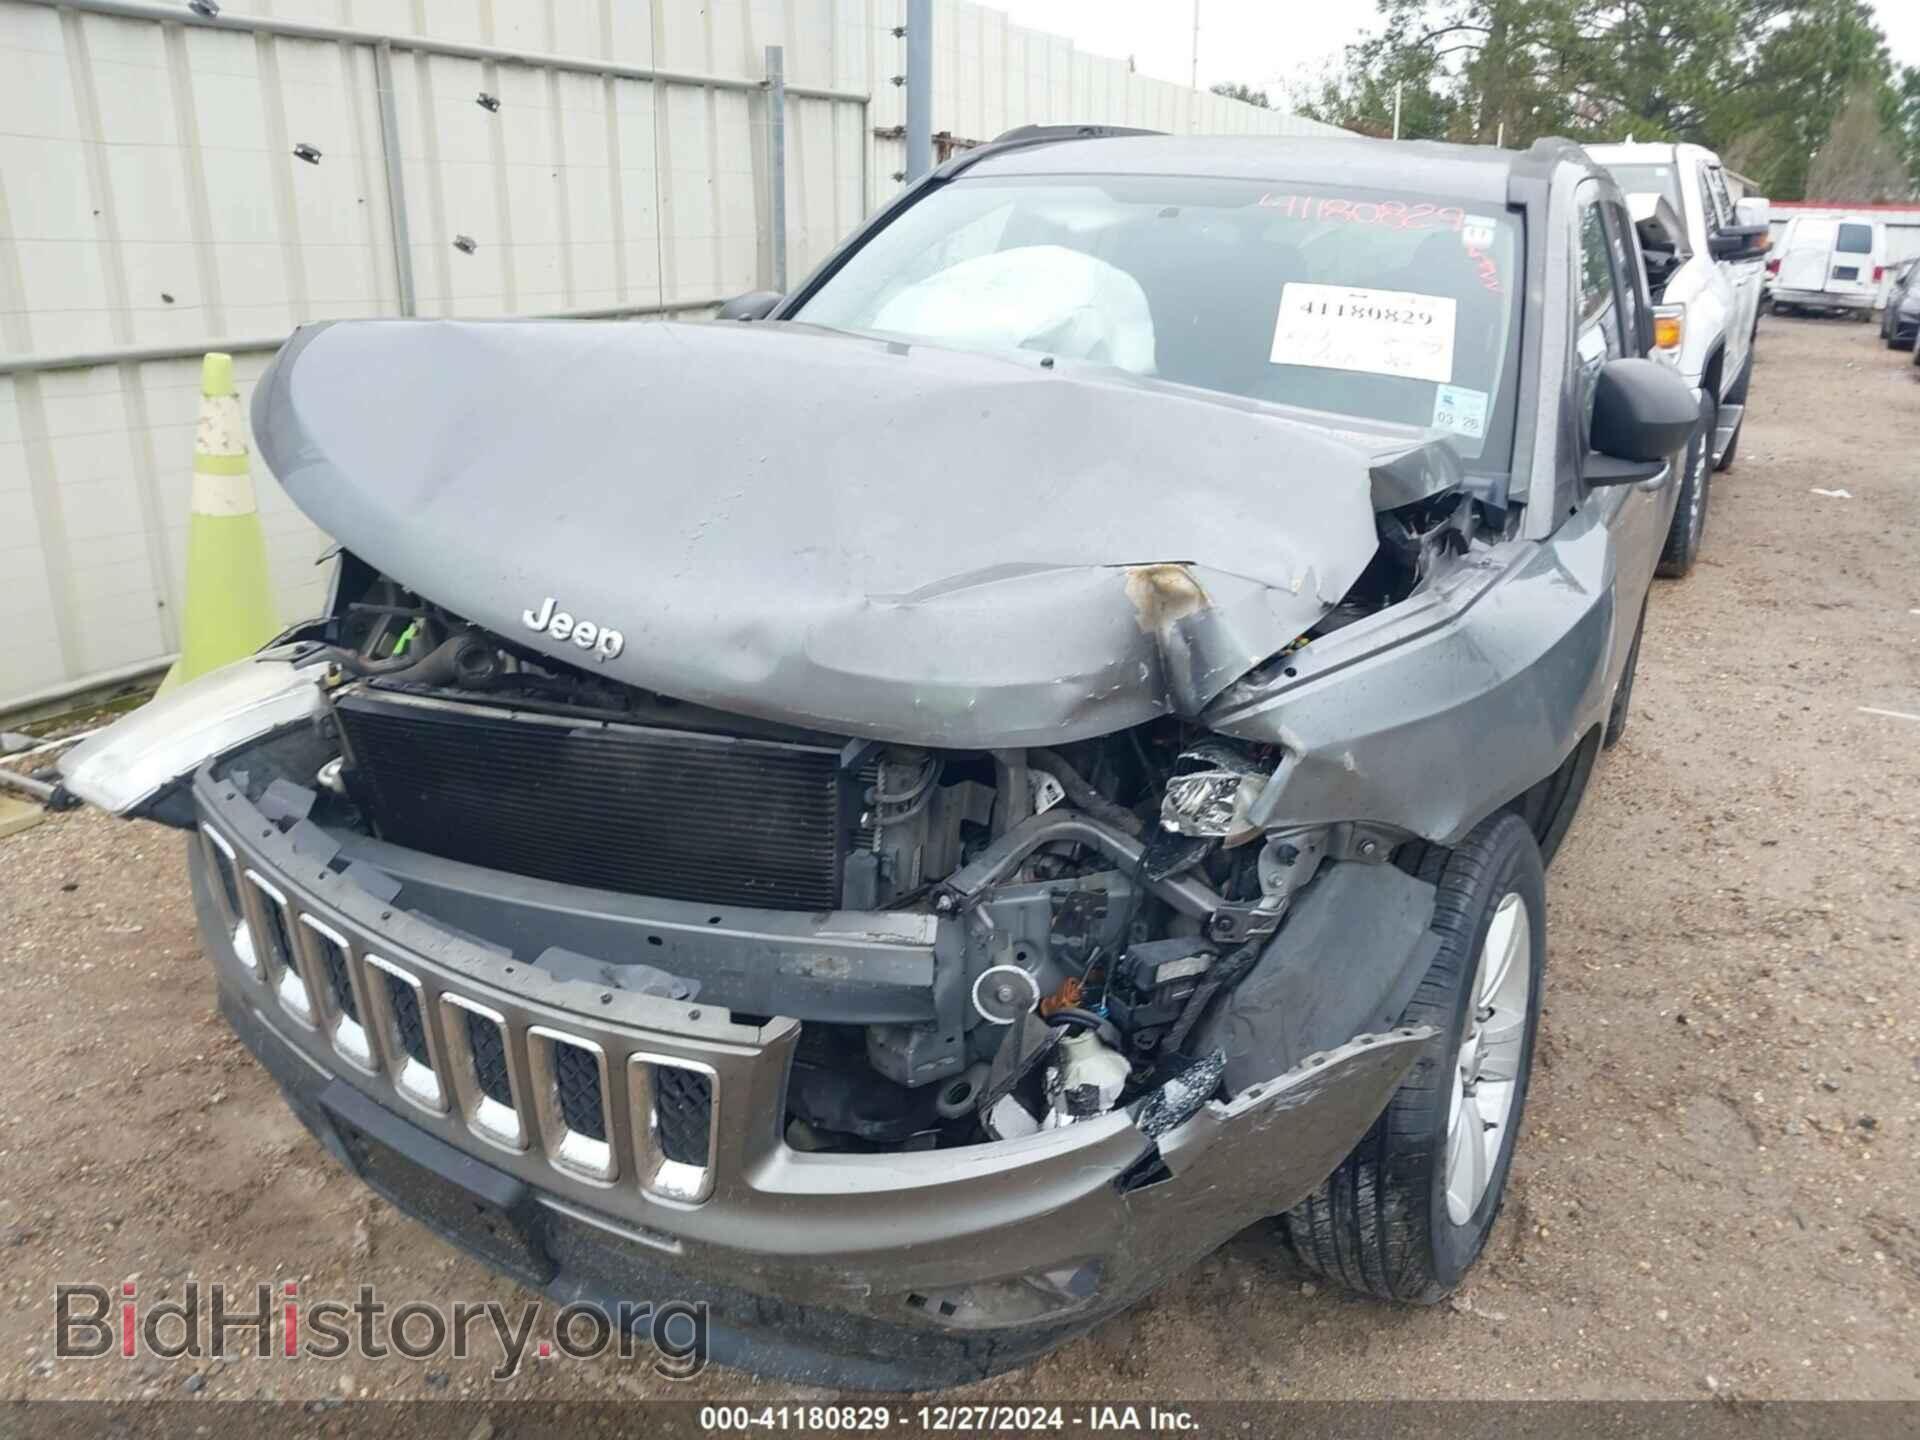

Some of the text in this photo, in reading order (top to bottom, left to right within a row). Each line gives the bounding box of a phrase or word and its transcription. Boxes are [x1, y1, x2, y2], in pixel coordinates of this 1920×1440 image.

[1259, 193, 1464, 231] 41180829
[1300, 301, 1433, 325] 41180829
[523, 597, 624, 663] Jeep
